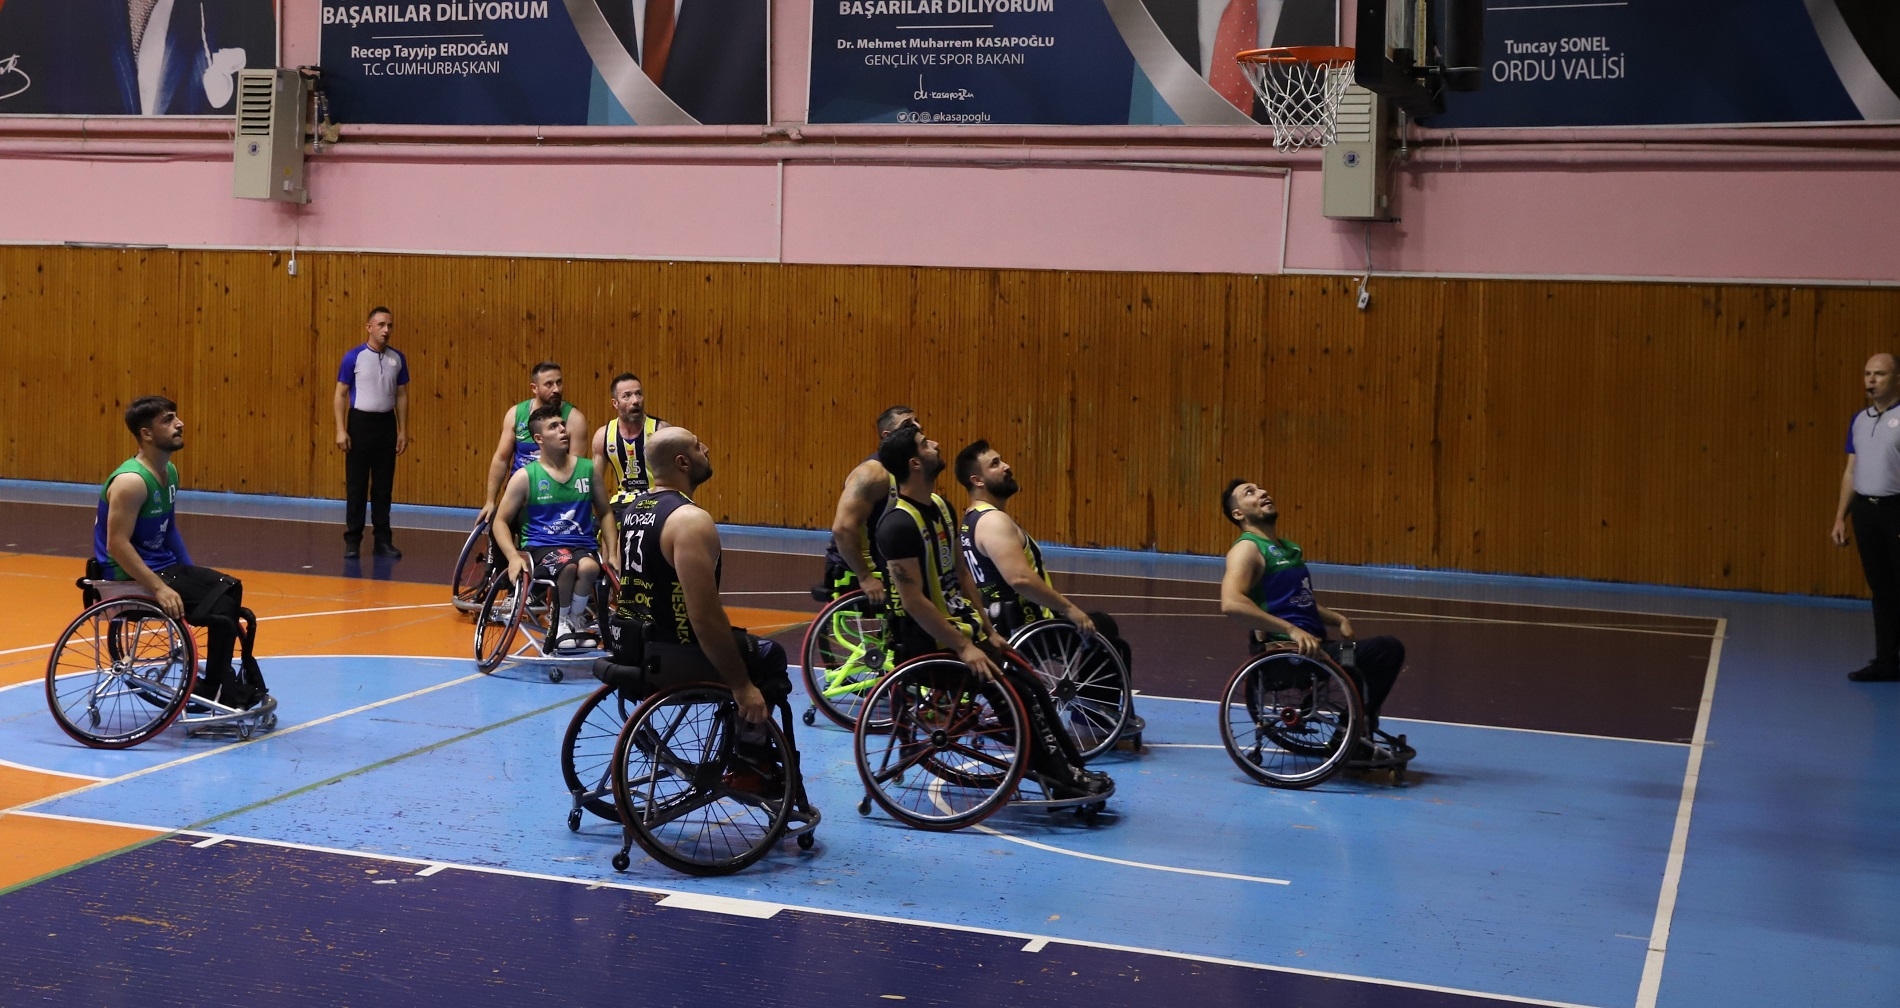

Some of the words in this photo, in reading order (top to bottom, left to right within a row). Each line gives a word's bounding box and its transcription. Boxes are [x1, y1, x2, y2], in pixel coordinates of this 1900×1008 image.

[322, 3, 431, 28] BAŞARILAR
[436, 0, 548, 21] DİLİYORUM
[838, 0, 943, 19] BAŞARILAR
[351, 45, 391, 60] Recep
[394, 43, 437, 60] Tayyip
[440, 40, 509, 57] ERDOĞAN
[837, 39, 855, 49] Dr.
[857, 38, 906, 49] Mehmet
[909, 37, 973, 48] Muharrem
[976, 35, 1055, 48] KASAPOĞLU
[1504, 39, 1557, 57] Tuncay
[1560, 37, 1610, 52] SONEL
[864, 52, 919, 68] GENÇLİK
[921, 54, 936, 65] VE
[939, 54, 973, 65] SPOR
[976, 53, 1025, 65] BAKANI
[1492, 59, 1556, 82] ORDU
[1561, 52, 1625, 80] VALİSİ
[363, 63, 384, 76] T.C.
[386, 61, 500, 77] CUMHURBAŞKANI
[933, 112, 991, 123] @kasapoglu
[624, 459, 641, 475] 35
[574, 477, 590, 493] 46
